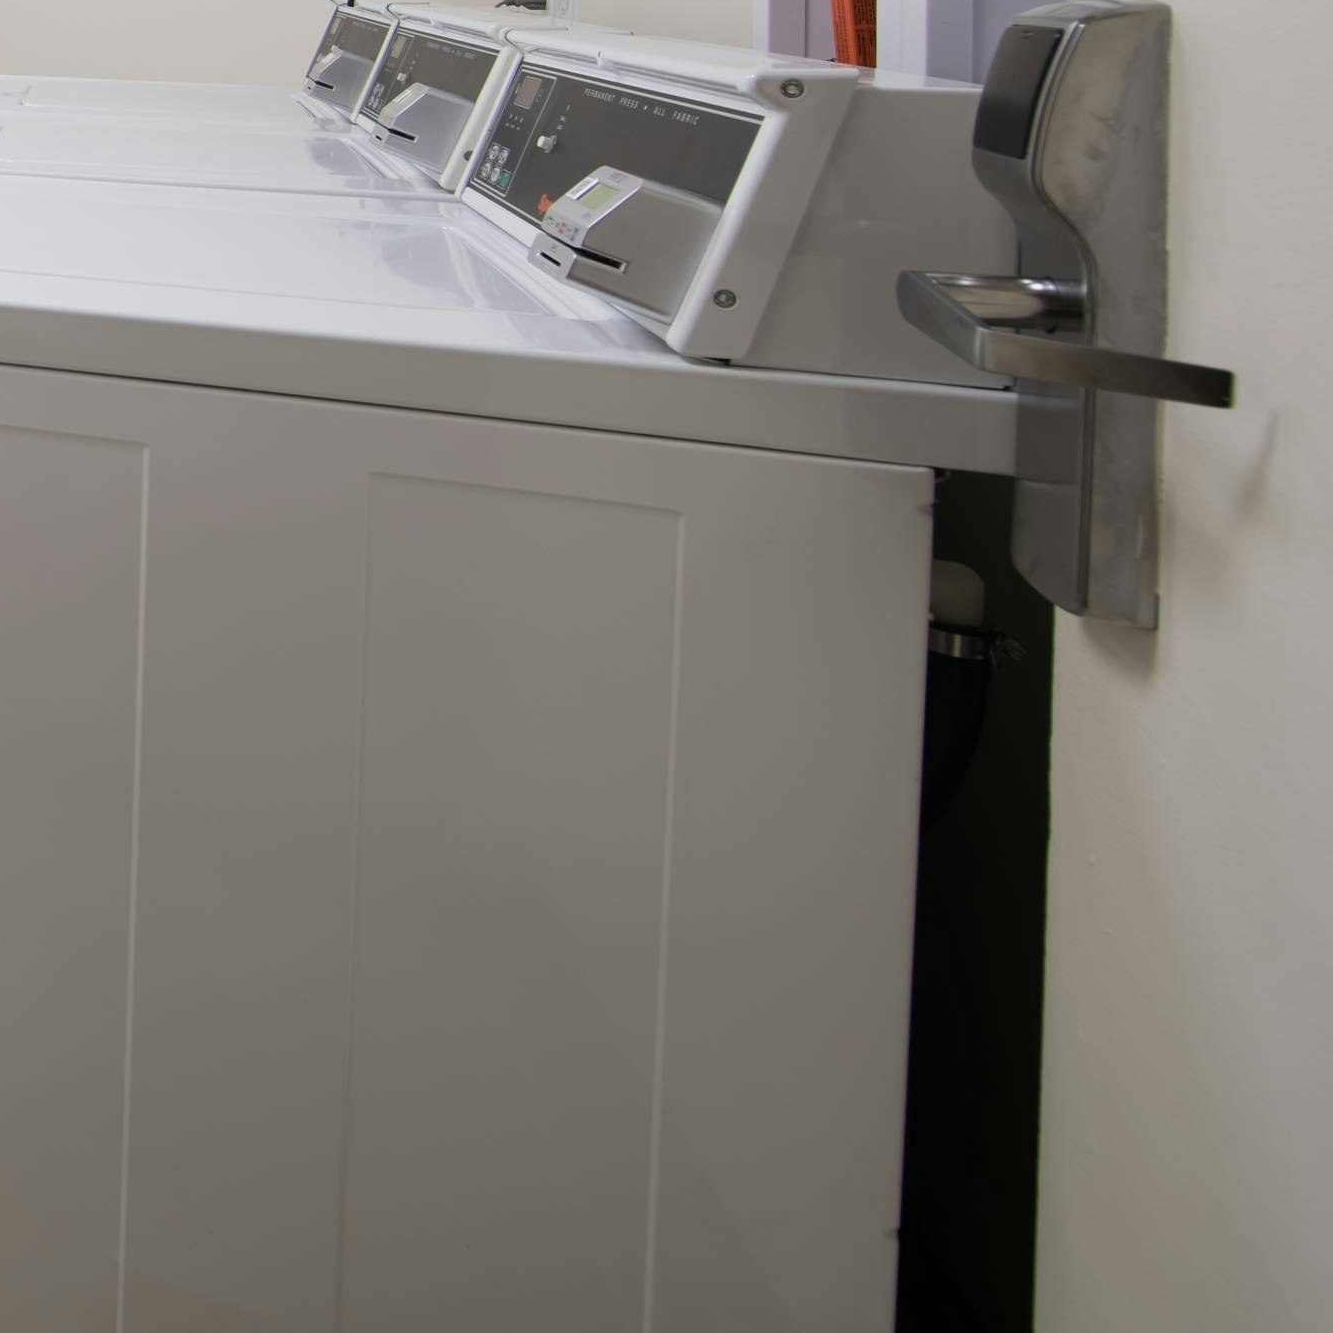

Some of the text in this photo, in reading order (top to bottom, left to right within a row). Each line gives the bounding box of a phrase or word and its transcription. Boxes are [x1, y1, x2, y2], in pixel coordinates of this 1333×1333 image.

[584, 87, 616, 104] PERMANENT
[619, 97, 641, 110] PRESS
[672, 110, 701, 126] FABRIC
